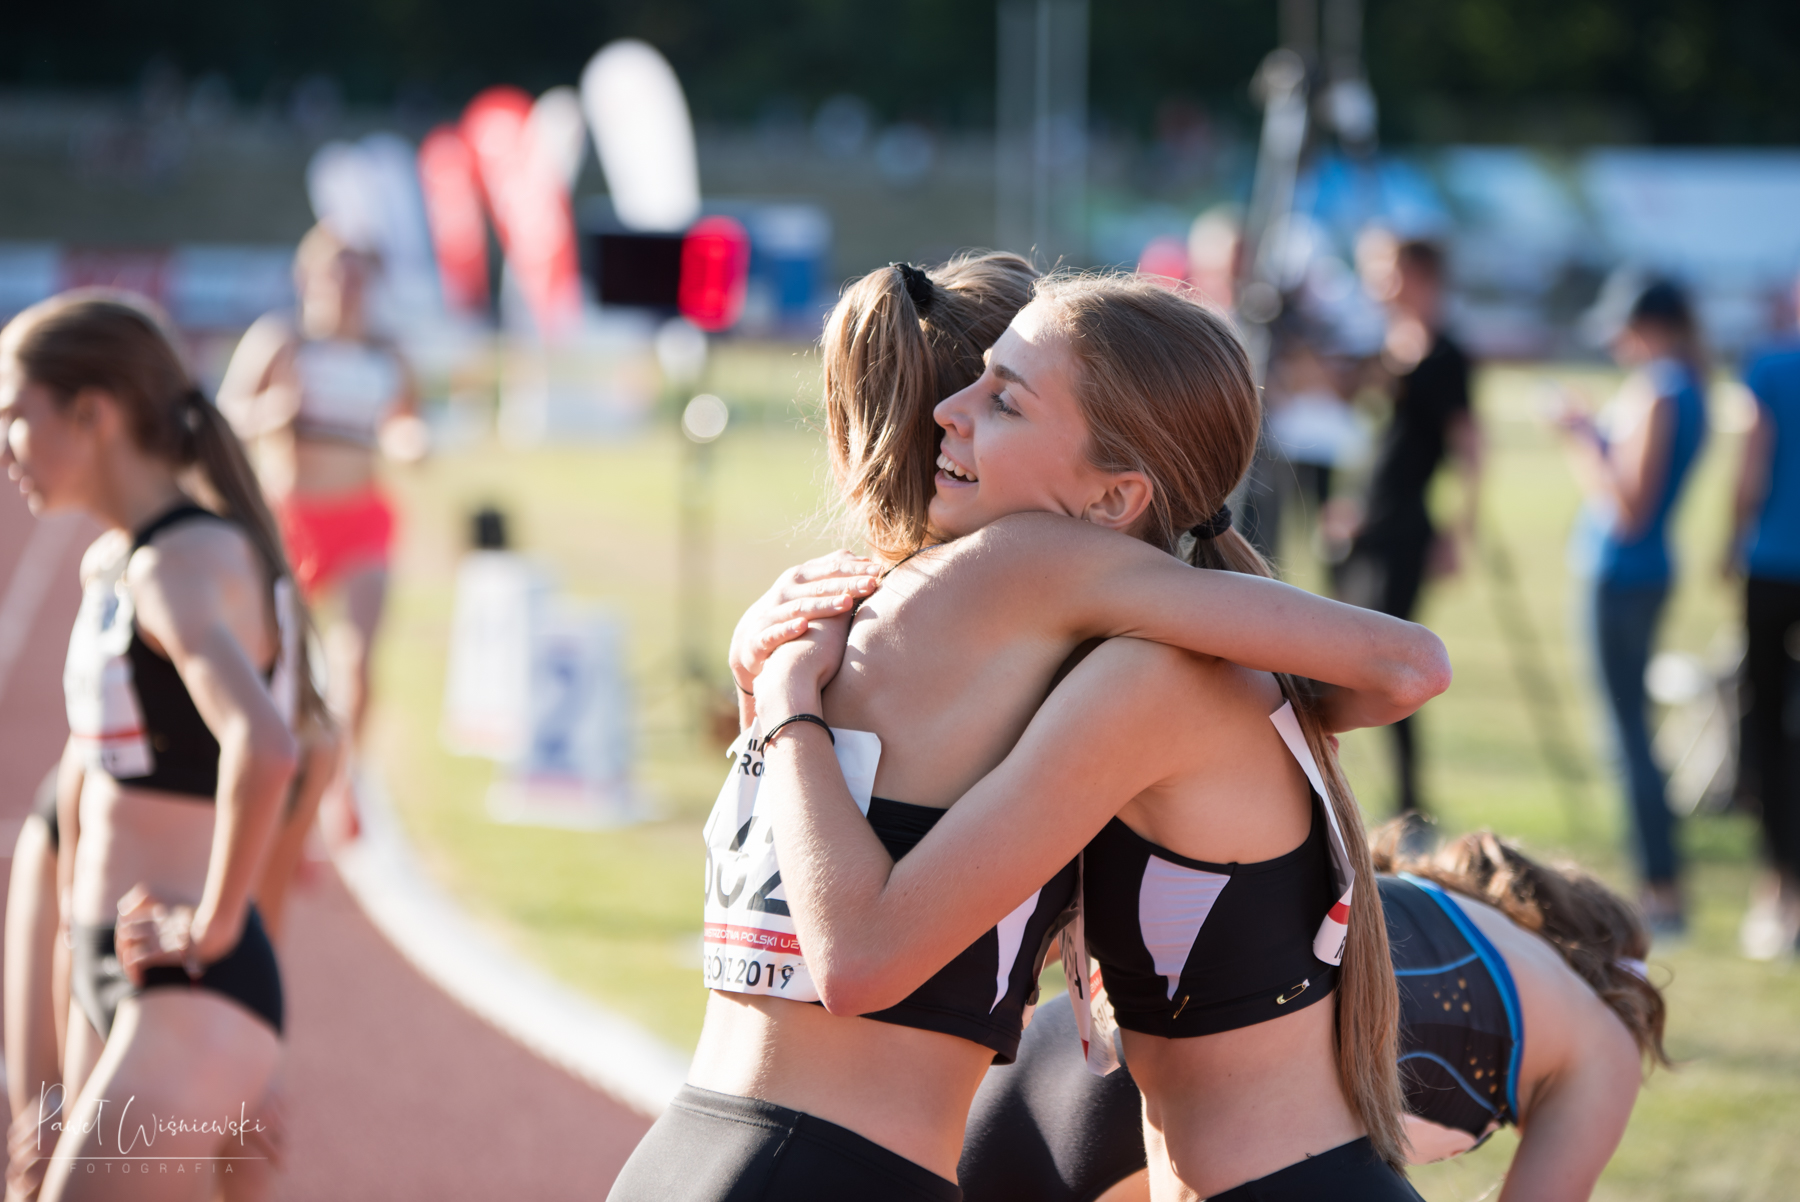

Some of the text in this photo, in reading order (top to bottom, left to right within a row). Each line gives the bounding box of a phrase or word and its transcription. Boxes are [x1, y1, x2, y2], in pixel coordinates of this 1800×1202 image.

[740, 931, 778, 946] POLSKI
[780, 938, 799, 950] U2
[734, 958, 795, 990] 2019
